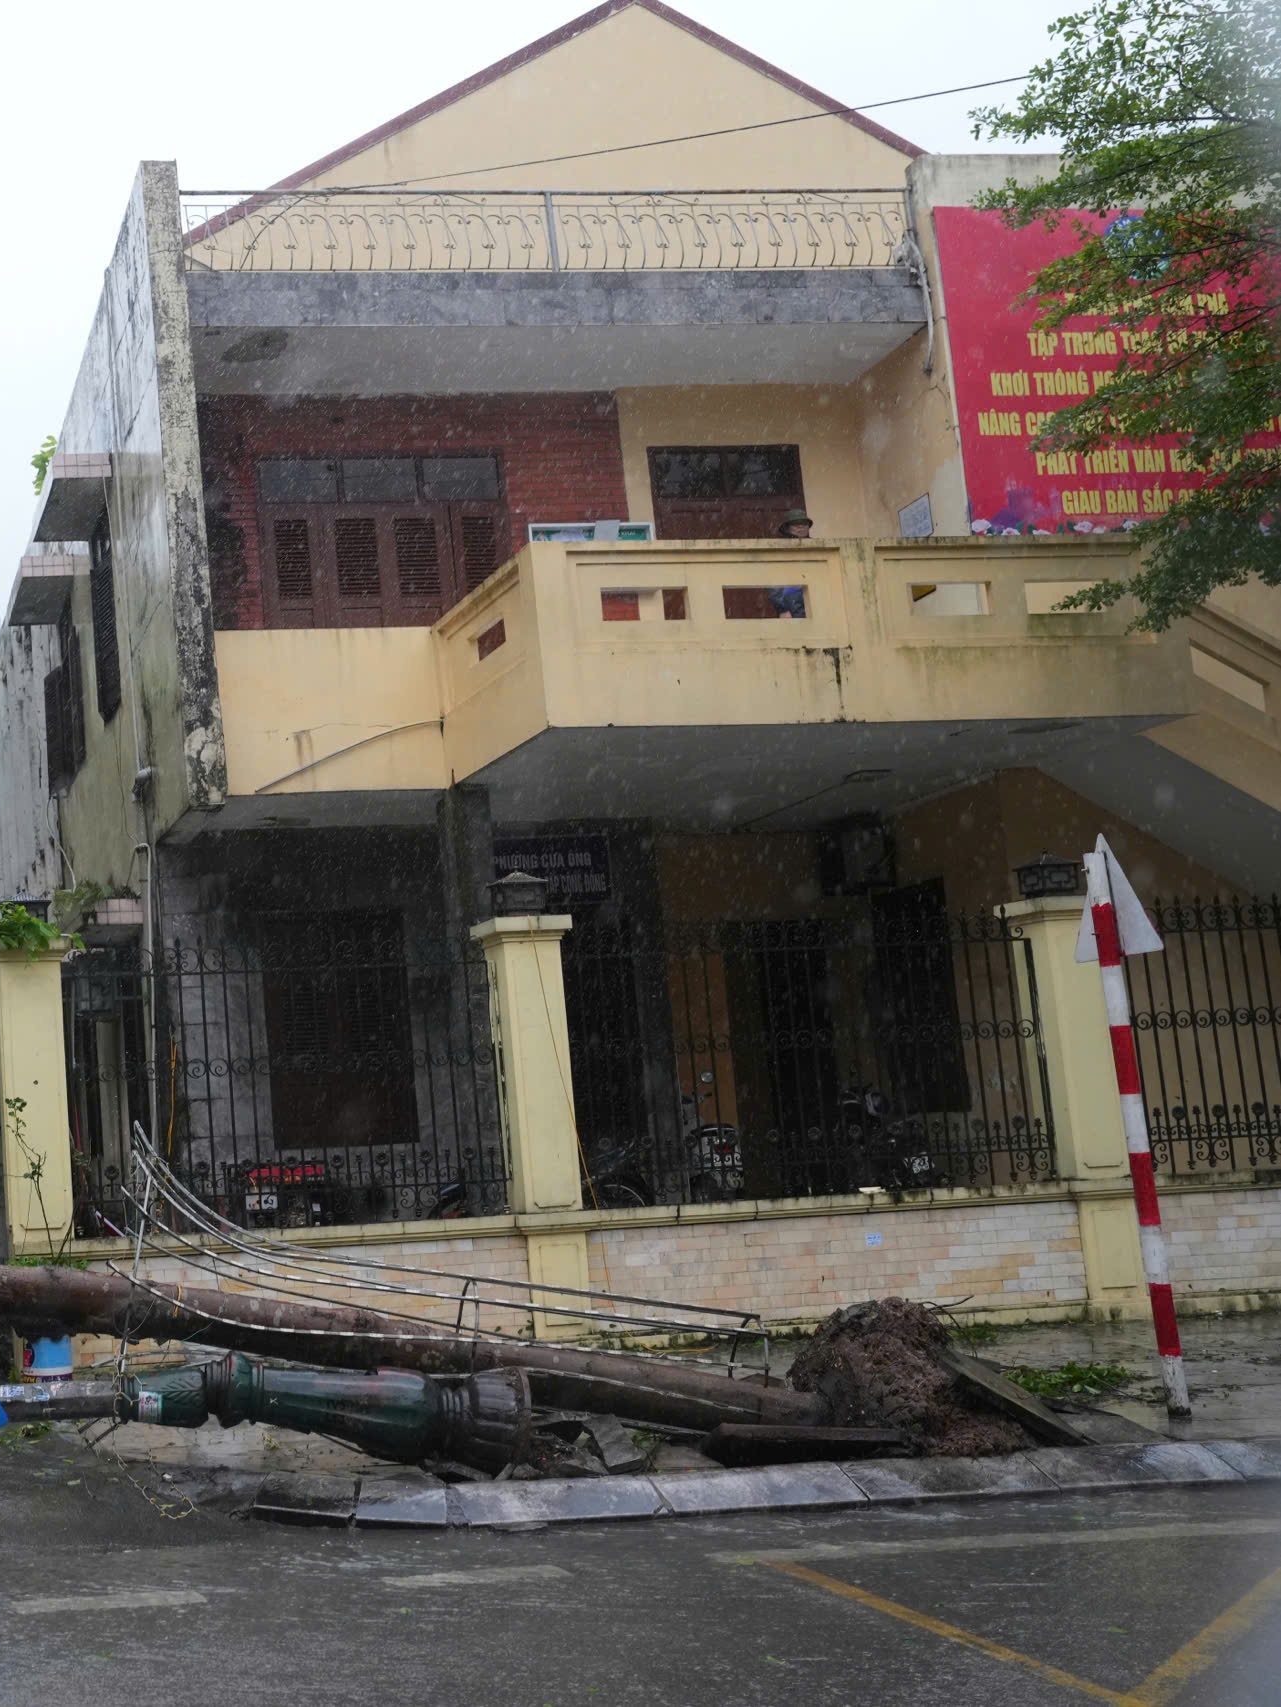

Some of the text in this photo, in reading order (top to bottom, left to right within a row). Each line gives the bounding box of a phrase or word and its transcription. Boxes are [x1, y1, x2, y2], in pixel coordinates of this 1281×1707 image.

[1027, 329, 1058, 361] TẬP
[1061, 331, 1118, 356] TRUNG
[990, 367, 1030, 396] KHƠI
[1033, 367, 1089, 396] THÔNG
[978, 408, 1022, 436] NÂNG
[1084, 441, 1129, 474] TRIỂN
[1132, 445, 1166, 473] VĂN
[1062, 486, 1101, 514] GIÀU
[1105, 484, 1139, 514] BẢN
[1142, 481, 1174, 513] SẮC
